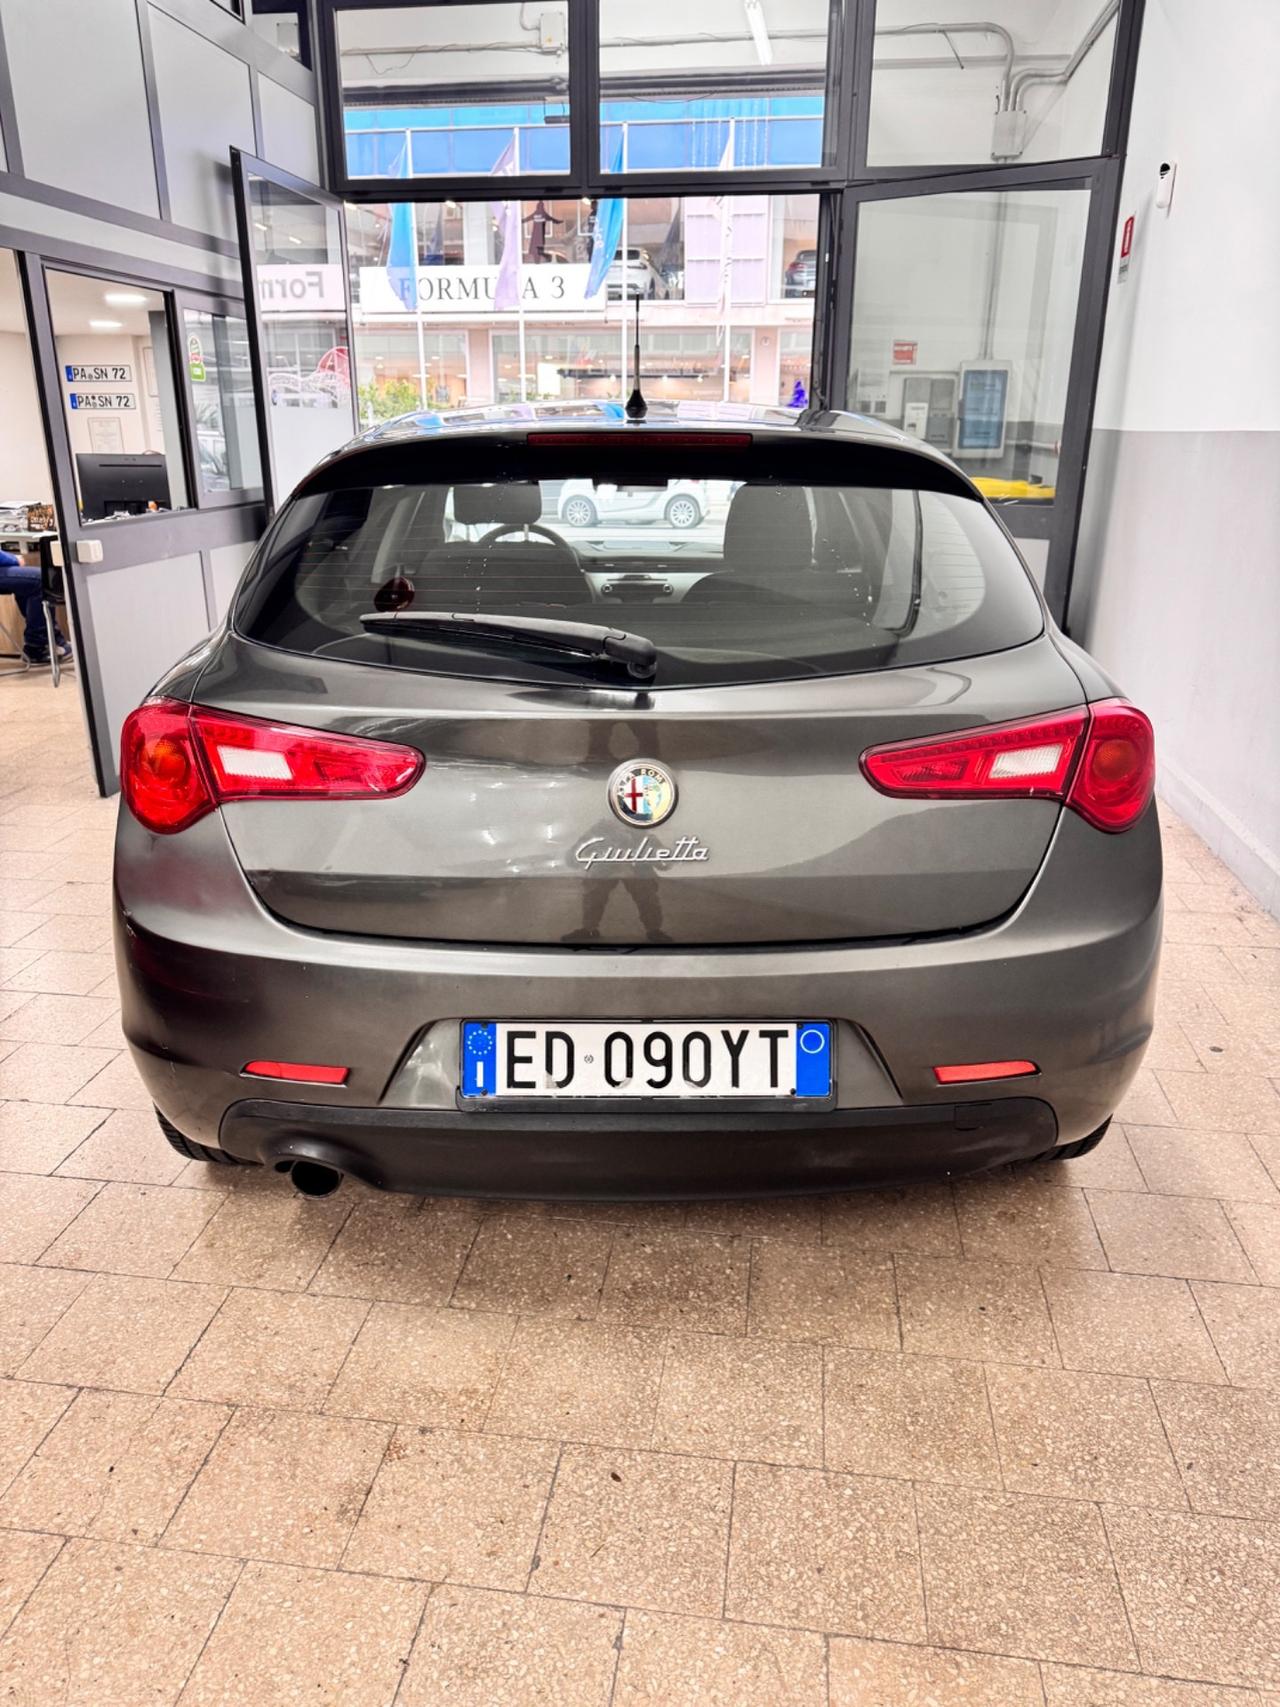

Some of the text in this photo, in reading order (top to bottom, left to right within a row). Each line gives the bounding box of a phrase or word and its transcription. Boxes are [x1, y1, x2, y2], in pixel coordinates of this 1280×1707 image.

[398, 275, 566, 301] FORMUA 3
[112, 367, 126, 380] 72
[116, 395, 130, 408] 72
[575, 835, 709, 870] Giulietta
